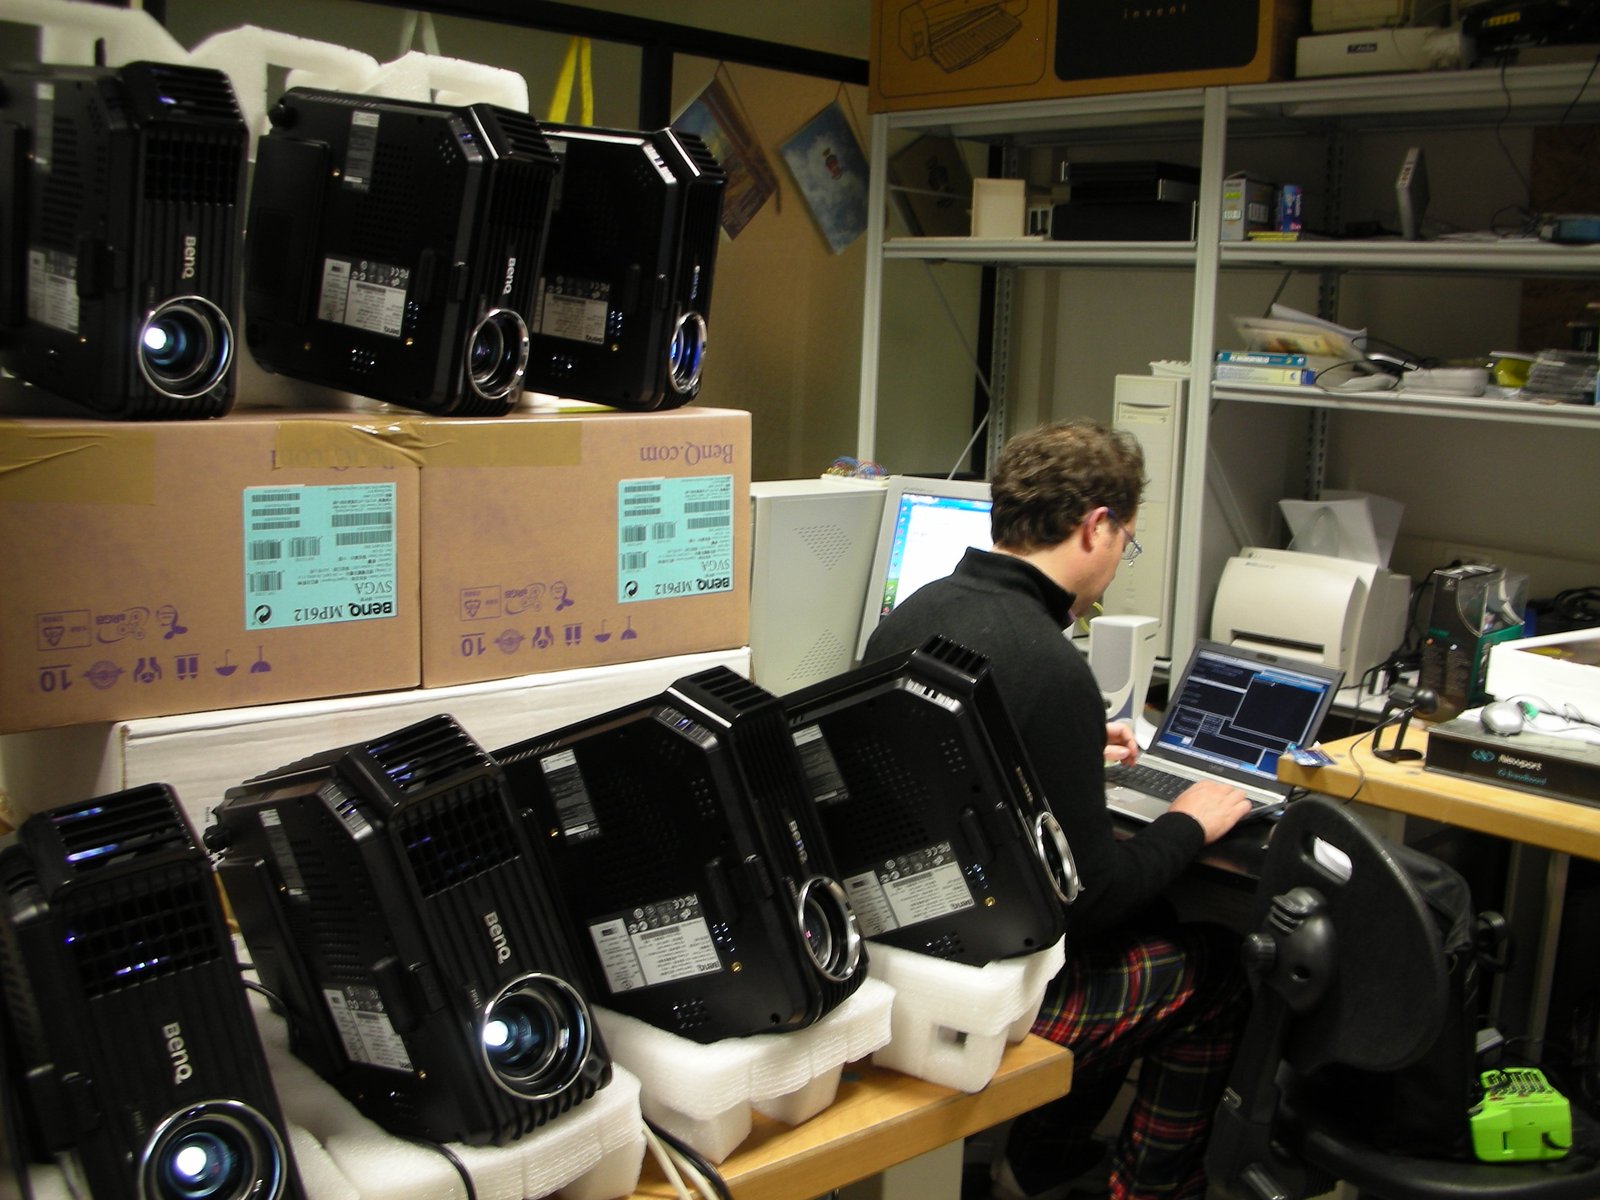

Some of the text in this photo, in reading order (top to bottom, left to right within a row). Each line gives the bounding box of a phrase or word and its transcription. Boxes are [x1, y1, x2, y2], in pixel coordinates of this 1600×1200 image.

[1123, 3, 1187, 20] invent
[182, 236, 197, 279] BenQ
[503, 257, 516, 295] BenQ
[639, 442, 735, 467] BenQ.com
[700, 559, 731, 573] SVGA
[354, 580, 394, 595] SVGA
[654, 577, 731, 596] BenQ MP612
[294, 601, 393, 622] BenQ MP612
[461, 638, 486, 657] 10
[39, 670, 72, 693] 10
[484, 912, 512, 965] BenQ
[162, 1022, 193, 1085] BenQ
